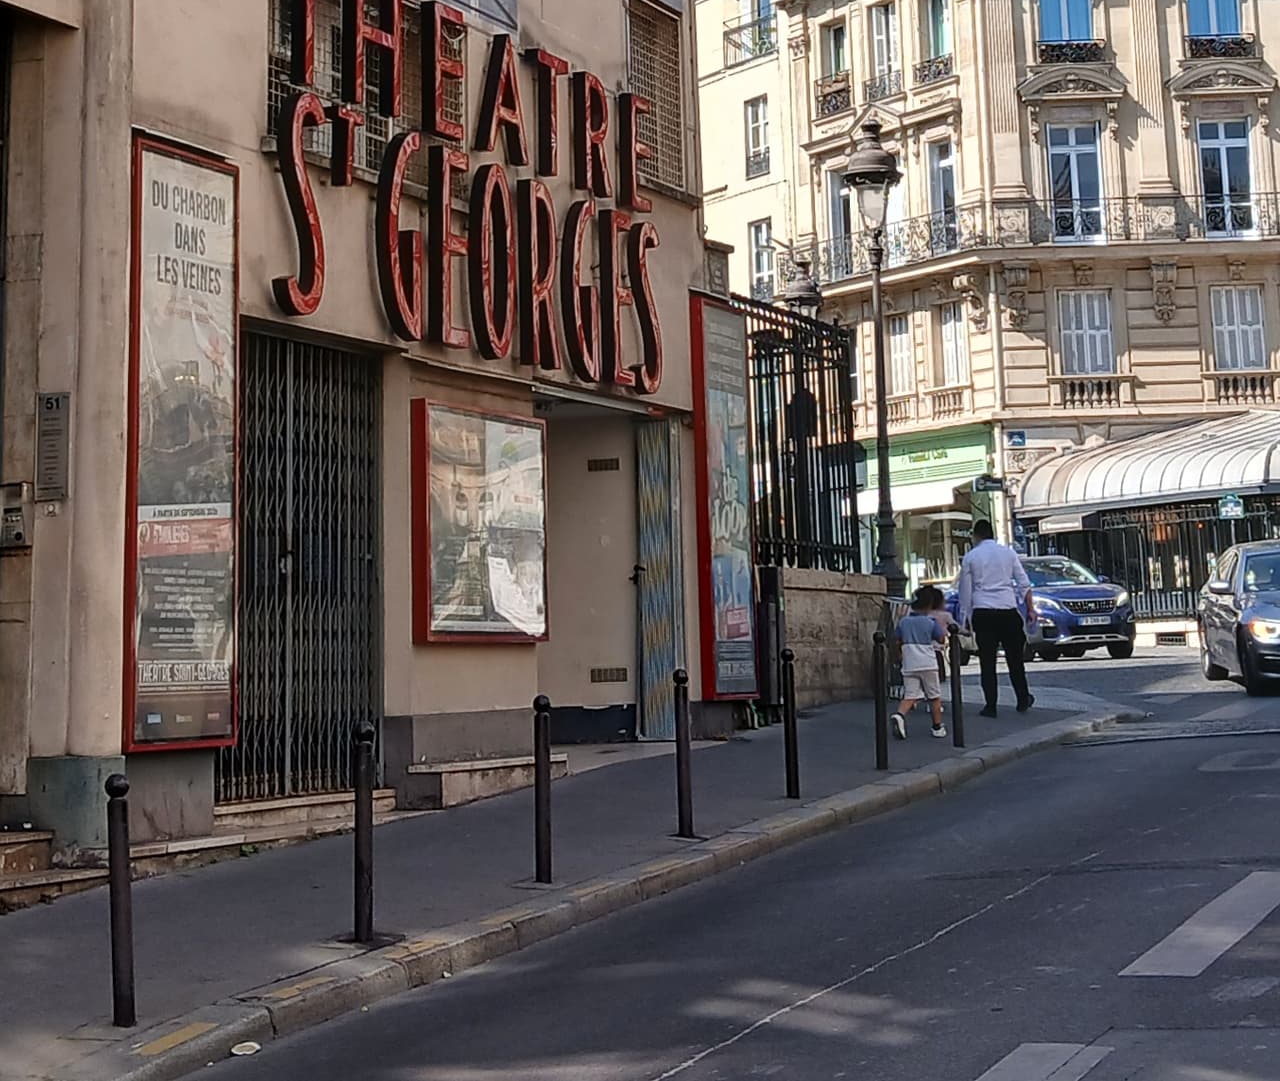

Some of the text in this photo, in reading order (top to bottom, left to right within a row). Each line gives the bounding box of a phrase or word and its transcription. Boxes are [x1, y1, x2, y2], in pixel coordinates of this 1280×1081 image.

[152, 179, 227, 226] DU CHARBON
[174, 222, 207, 256] DANS
[157, 254, 222, 296] LES VEINES
[376, 131, 664, 395] GEORGES
[45, 397, 61, 410] 51
